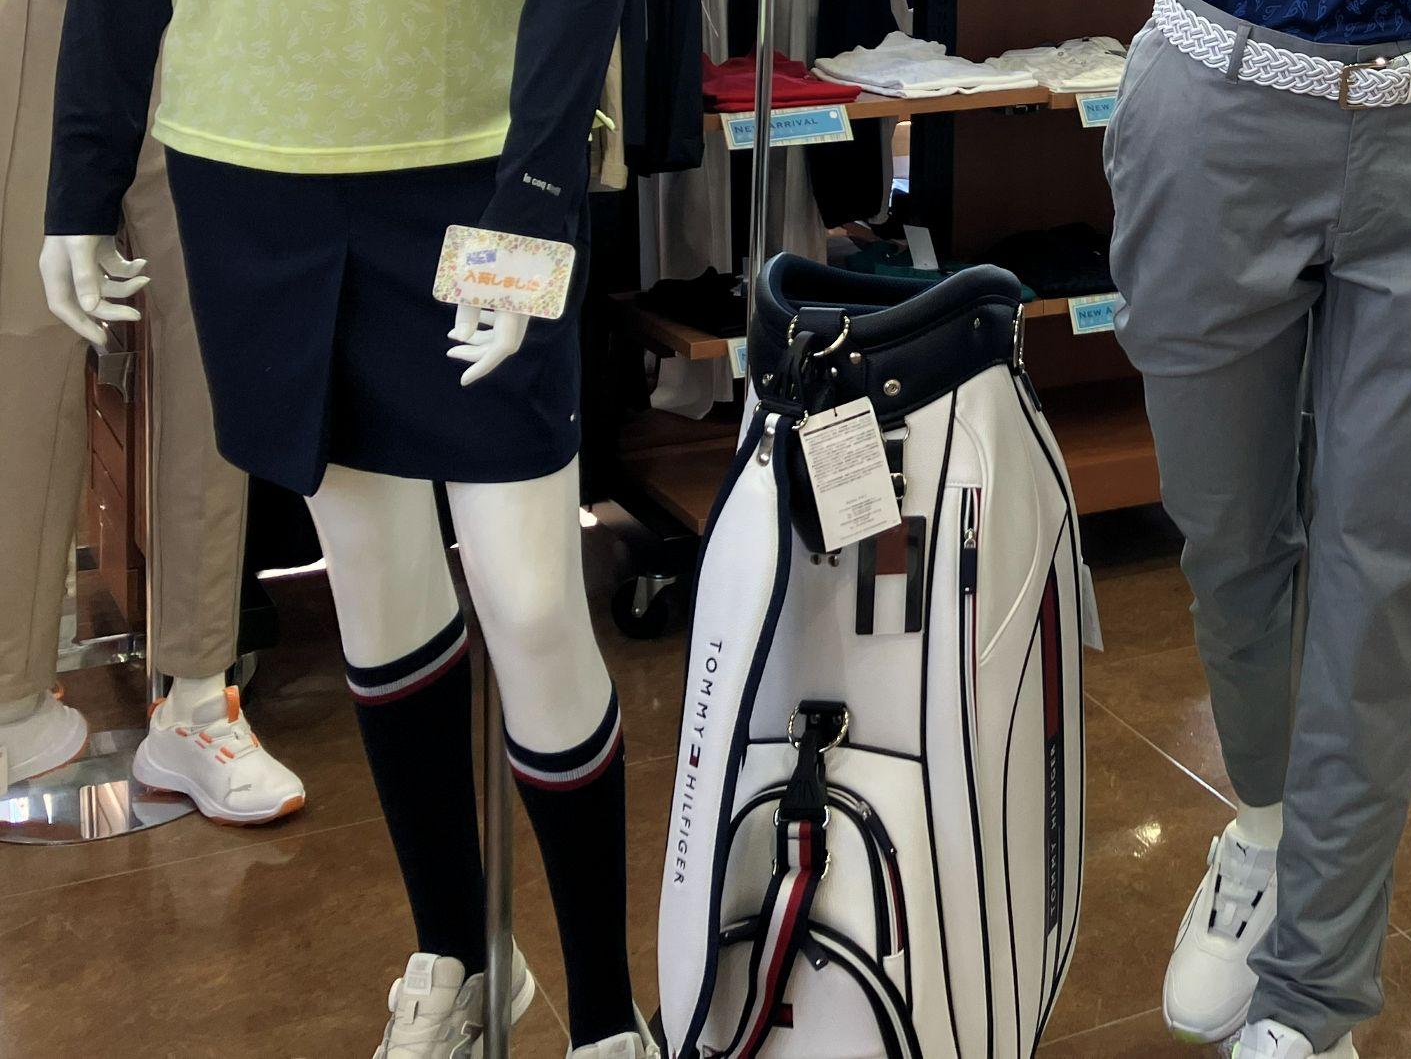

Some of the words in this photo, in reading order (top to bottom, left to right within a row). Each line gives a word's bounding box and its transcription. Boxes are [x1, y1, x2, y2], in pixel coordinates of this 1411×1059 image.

[733, 125, 755, 134] NE
[1086, 103, 1110, 112] NEW
[1079, 309, 1102, 319] NEW
[693, 640, 723, 739] TOMMY
[1050, 743, 1058, 830] HILFIGER
[673, 774, 697, 884] HILFIGER
